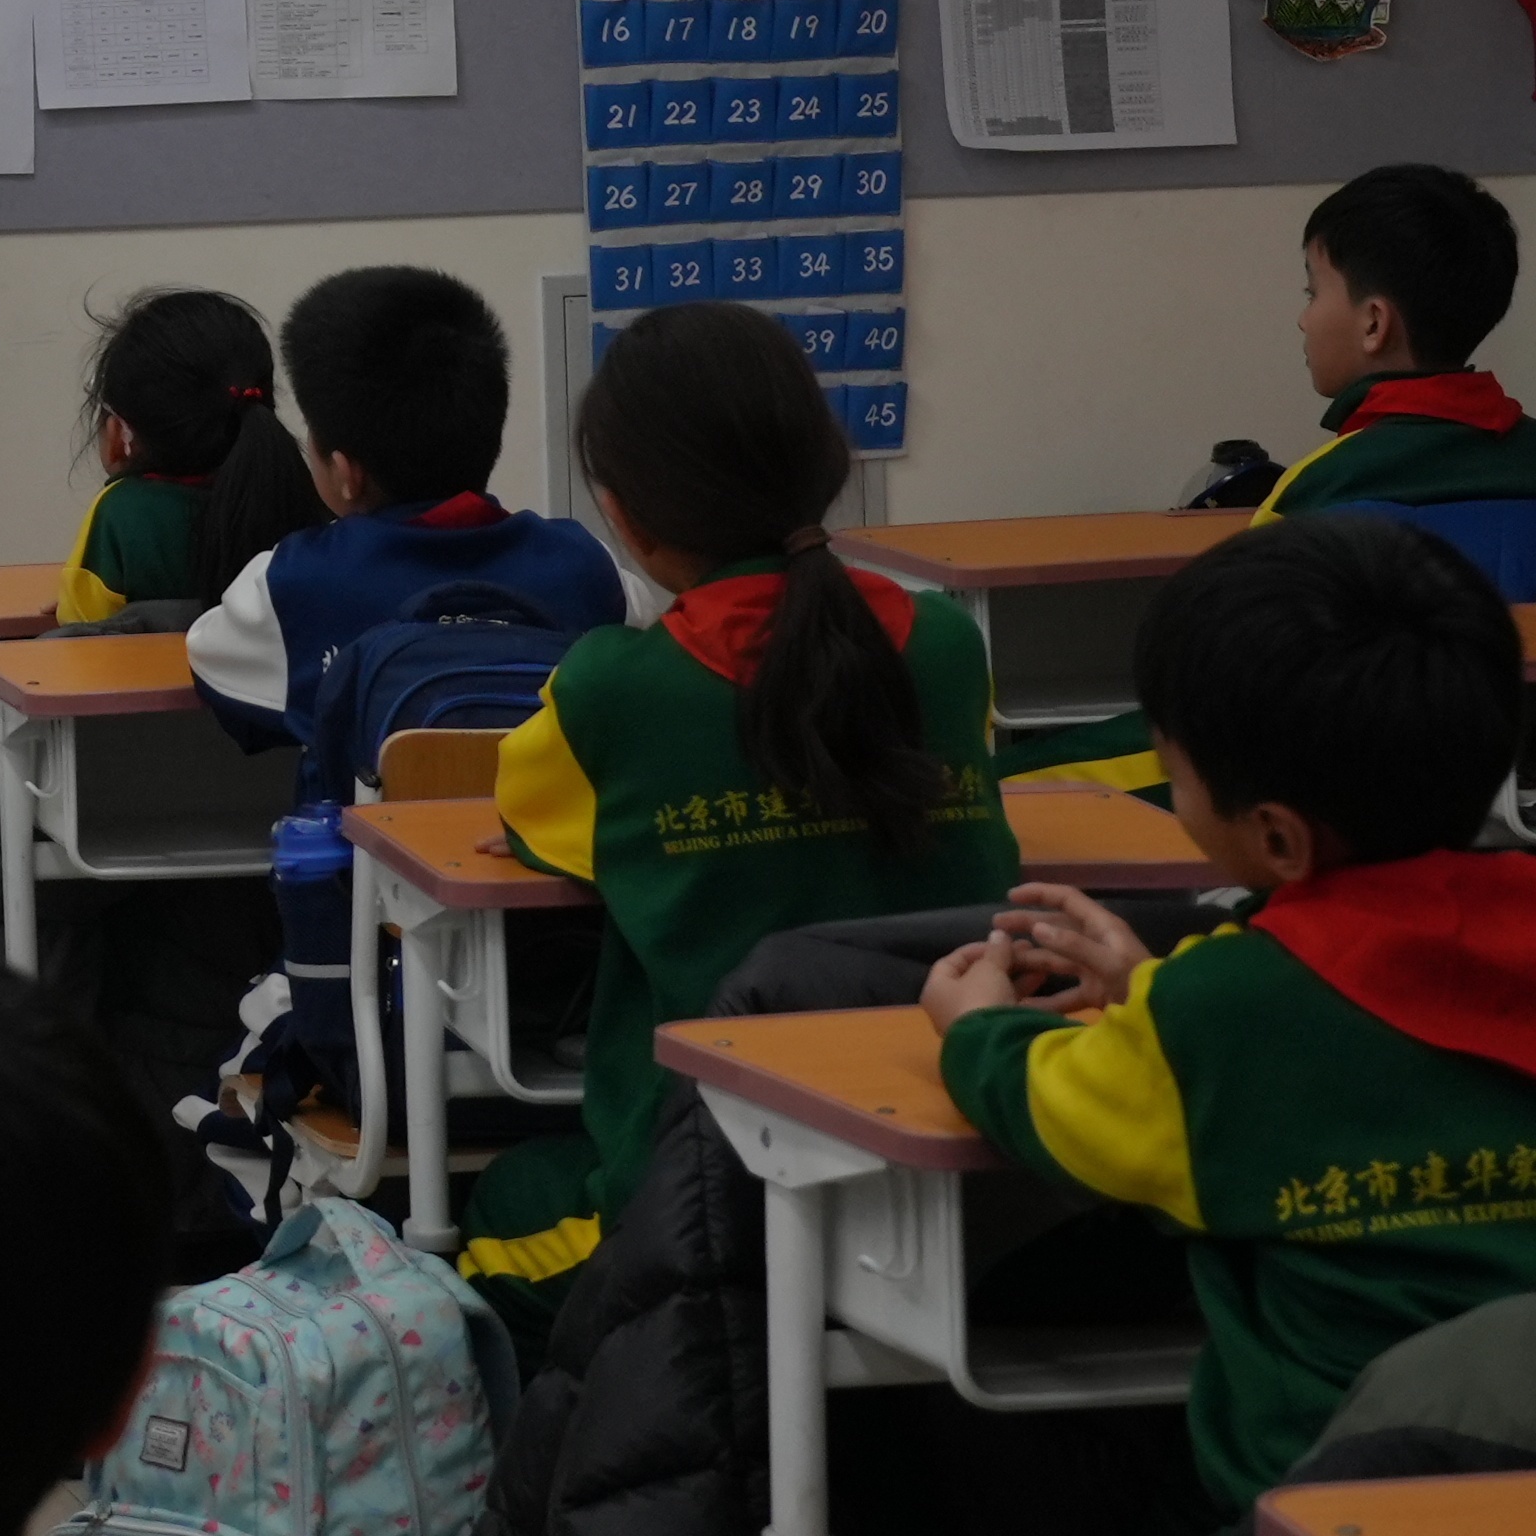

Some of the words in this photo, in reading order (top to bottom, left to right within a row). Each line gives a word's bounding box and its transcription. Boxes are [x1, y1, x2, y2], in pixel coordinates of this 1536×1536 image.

[603, 17, 630, 42] 16
[666, 18, 694, 41] 17
[728, 17, 756, 40] 18
[791, 15, 818, 38] 19
[857, 9, 887, 34] 20
[608, 105, 636, 129] 21
[665, 101, 696, 125] 22
[728, 98, 760, 123] 23
[790, 97, 820, 120] 24
[857, 93, 888, 118] 25
[606, 186, 637, 210] 26
[665, 183, 697, 206] 27
[731, 180, 762, 203] 28
[791, 174, 822, 199] 29
[857, 170, 887, 195] 30
[616, 267, 643, 291] 31
[672, 261, 700, 287] 32
[733, 257, 762, 282] 33
[801, 252, 830, 277] 34
[865, 246, 894, 272] 35
[805, 330, 834, 353] 39
[864, 328, 898, 351] 40
[865, 403, 896, 428] 45
